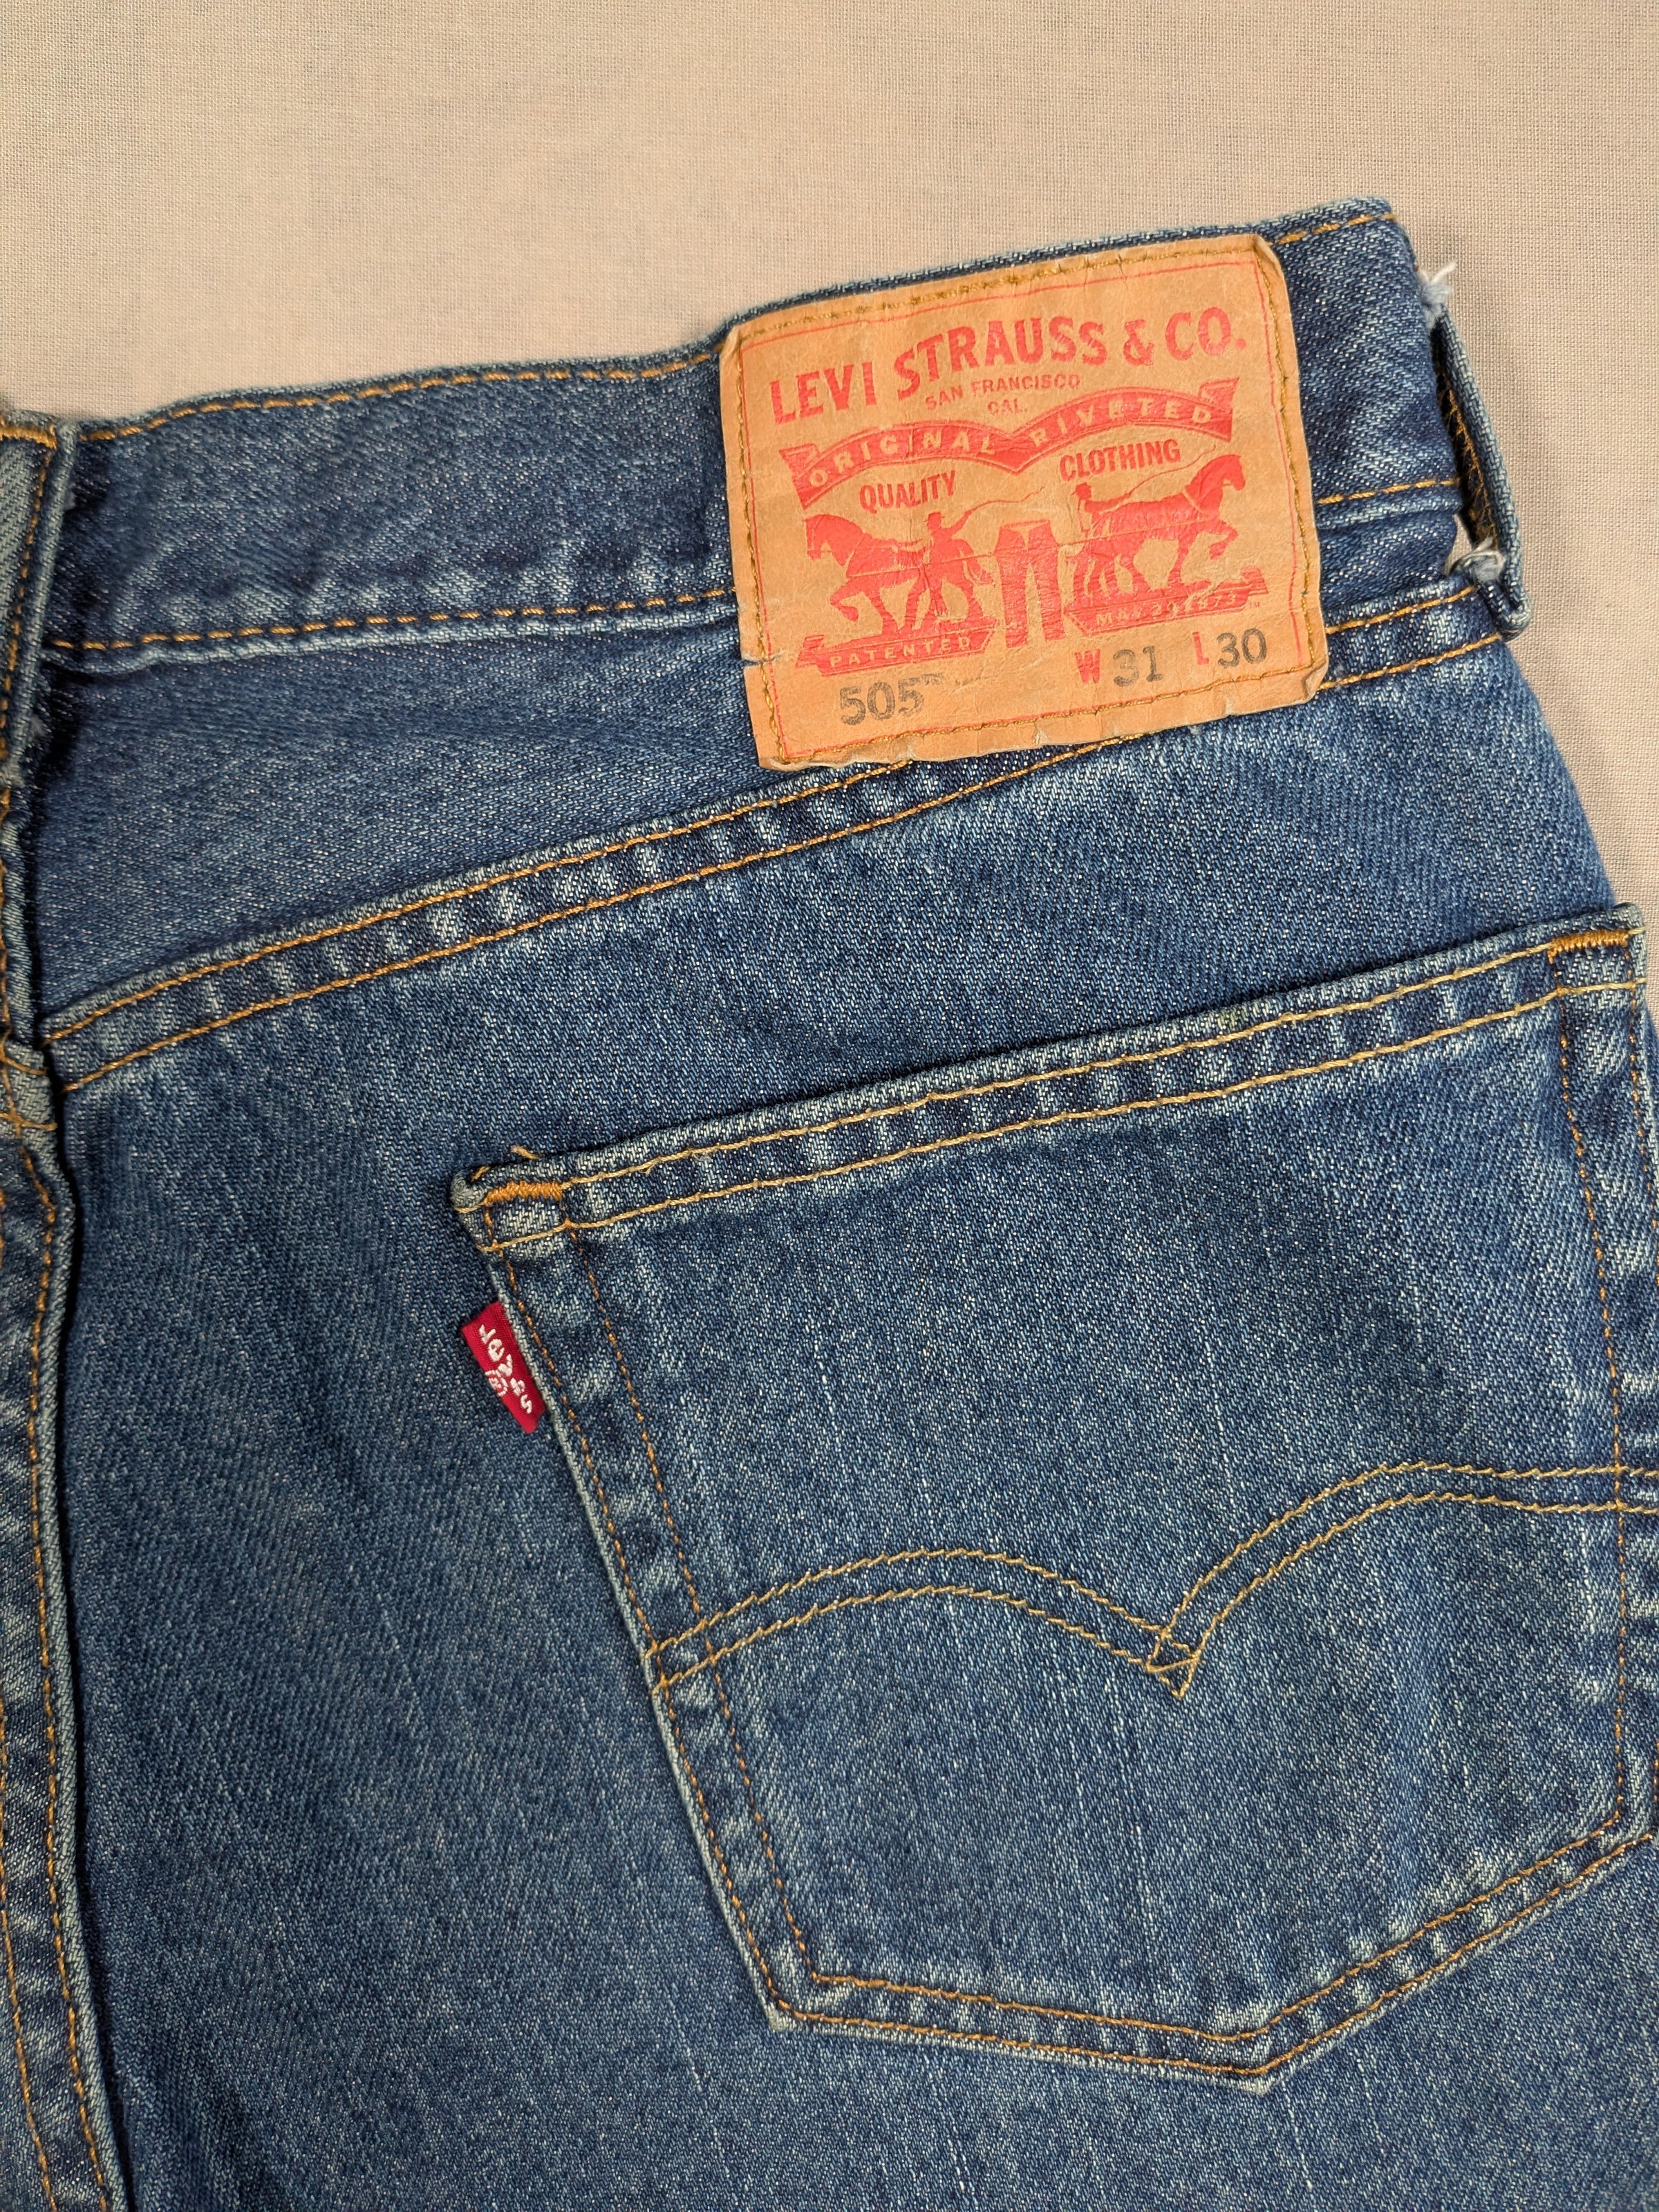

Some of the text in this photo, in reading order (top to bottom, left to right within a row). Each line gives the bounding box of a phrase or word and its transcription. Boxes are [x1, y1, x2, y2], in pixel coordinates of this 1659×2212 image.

[769, 306, 1247, 426] LEVI STRAUSS & CO.
[925, 373, 1080, 411] SAN FRANCISCO
[987, 397, 1029, 415] CAL.
[809, 397, 1211, 487] ORIGINAL RIVETED
[1059, 438, 1181, 482] CLOTHING
[859, 469, 956, 514] QUALITY
[830, 635, 971, 668] PATENTED
[1112, 645, 1163, 687] 31
[1216, 628, 1268, 669] 30
